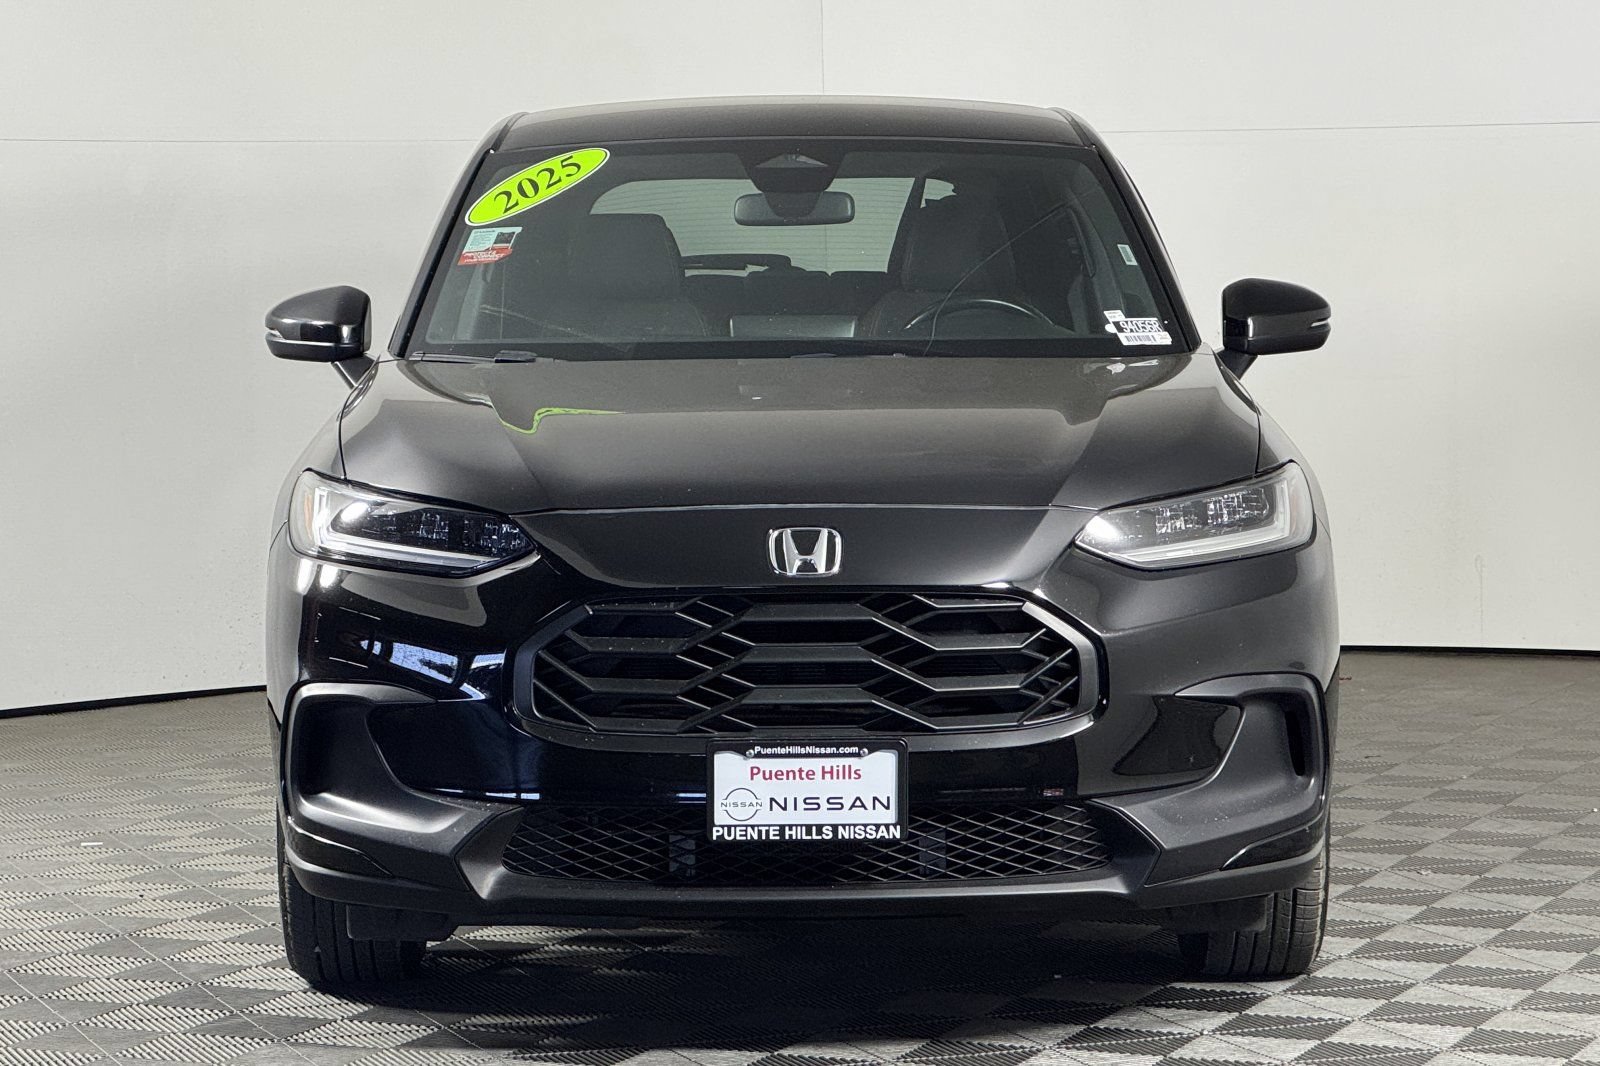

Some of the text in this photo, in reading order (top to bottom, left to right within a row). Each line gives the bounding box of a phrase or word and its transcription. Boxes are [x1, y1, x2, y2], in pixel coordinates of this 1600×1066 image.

[493, 155, 582, 214] 2025
[754, 746, 859, 755] PuenteHillsNissan.com
[750, 764, 862, 781] Puente Hills
[769, 796, 891, 811] NISSAN
[712, 825, 901, 840] PUENTE HILLS NISSAN
